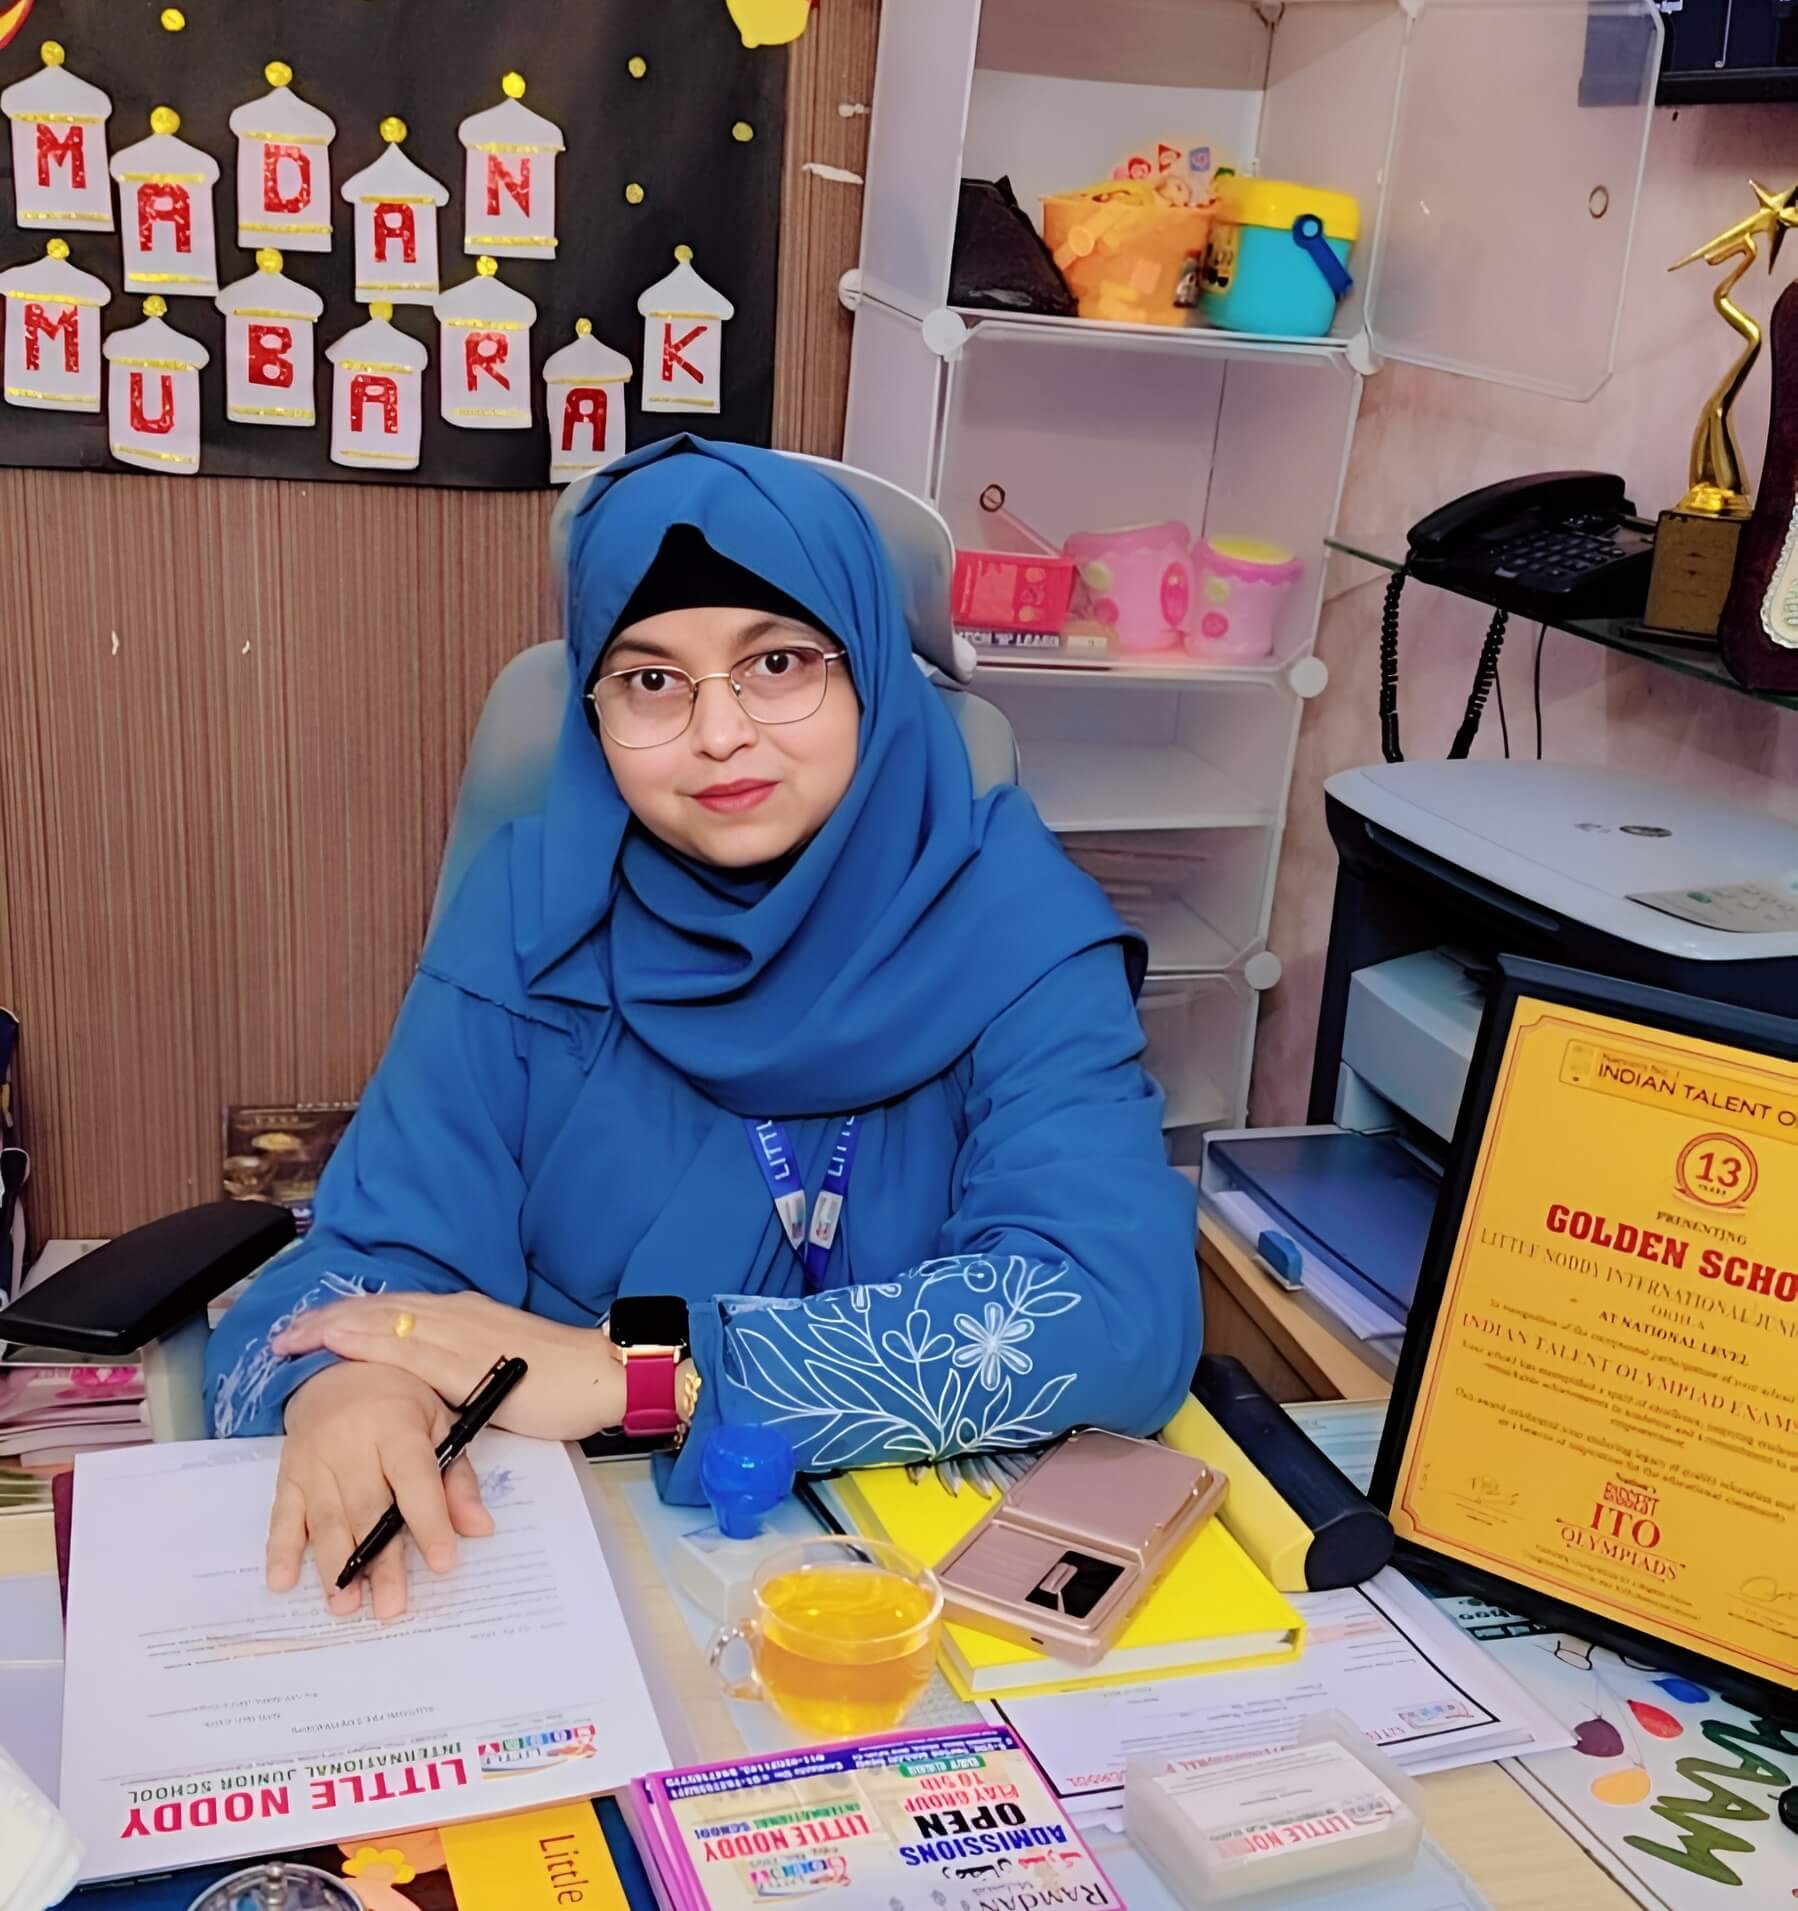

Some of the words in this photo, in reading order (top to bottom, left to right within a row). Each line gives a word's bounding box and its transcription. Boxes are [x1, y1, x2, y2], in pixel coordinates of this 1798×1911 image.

[37, 124, 531, 262] MADAN
[25, 304, 707, 451] MUBARAK
[1597, 1062, 1676, 1095] INDIAN
[1684, 1084, 1771, 1120] TALENT
[1776, 1108, 1798, 1128] O
[1694, 1149, 1743, 1188] 13
[1544, 1202, 1689, 1269] GOLDEN
[1656, 1210, 1748, 1247] PRESENTING
[1479, 1227, 1540, 1259] LITTLE
[1543, 1247, 1601, 1278] NODDY
[1605, 1267, 1747, 1325] INTERNATIONAL
[1597, 1309, 1619, 1325] AT
[1619, 1316, 1697, 1350] NATIONAL
[1700, 1341, 1751, 1367] LEVEL
[1461, 1312, 1528, 1347] INDIAN
[1534, 1337, 1610, 1373] TALENT
[1614, 1363, 1725, 1411] OLYMPIAD
[1588, 1502, 1663, 1551] ITO
[1559, 1525, 1679, 1580] OLYMPIADS
[220, 1767, 297, 1790] JUNIOR
[304, 1741, 461, 1777] INTERNATIONAL
[128, 1780, 211, 1803] SCHOOL
[308, 1757, 466, 1809] LITTLE
[903, 1789, 969, 1812] GROUP
[974, 1783, 1019, 1803] PLAY
[120, 1786, 290, 1838] NODDY
[789, 1814, 869, 1847] LITTLE
[912, 1801, 1026, 1840] OPEN
[1286, 1814, 1349, 1843] LITTLE
[703, 1828, 788, 1862] NODDY
[898, 1824, 1066, 1868] ADMISSIONS
[538, 1834, 589, 1905] Little
